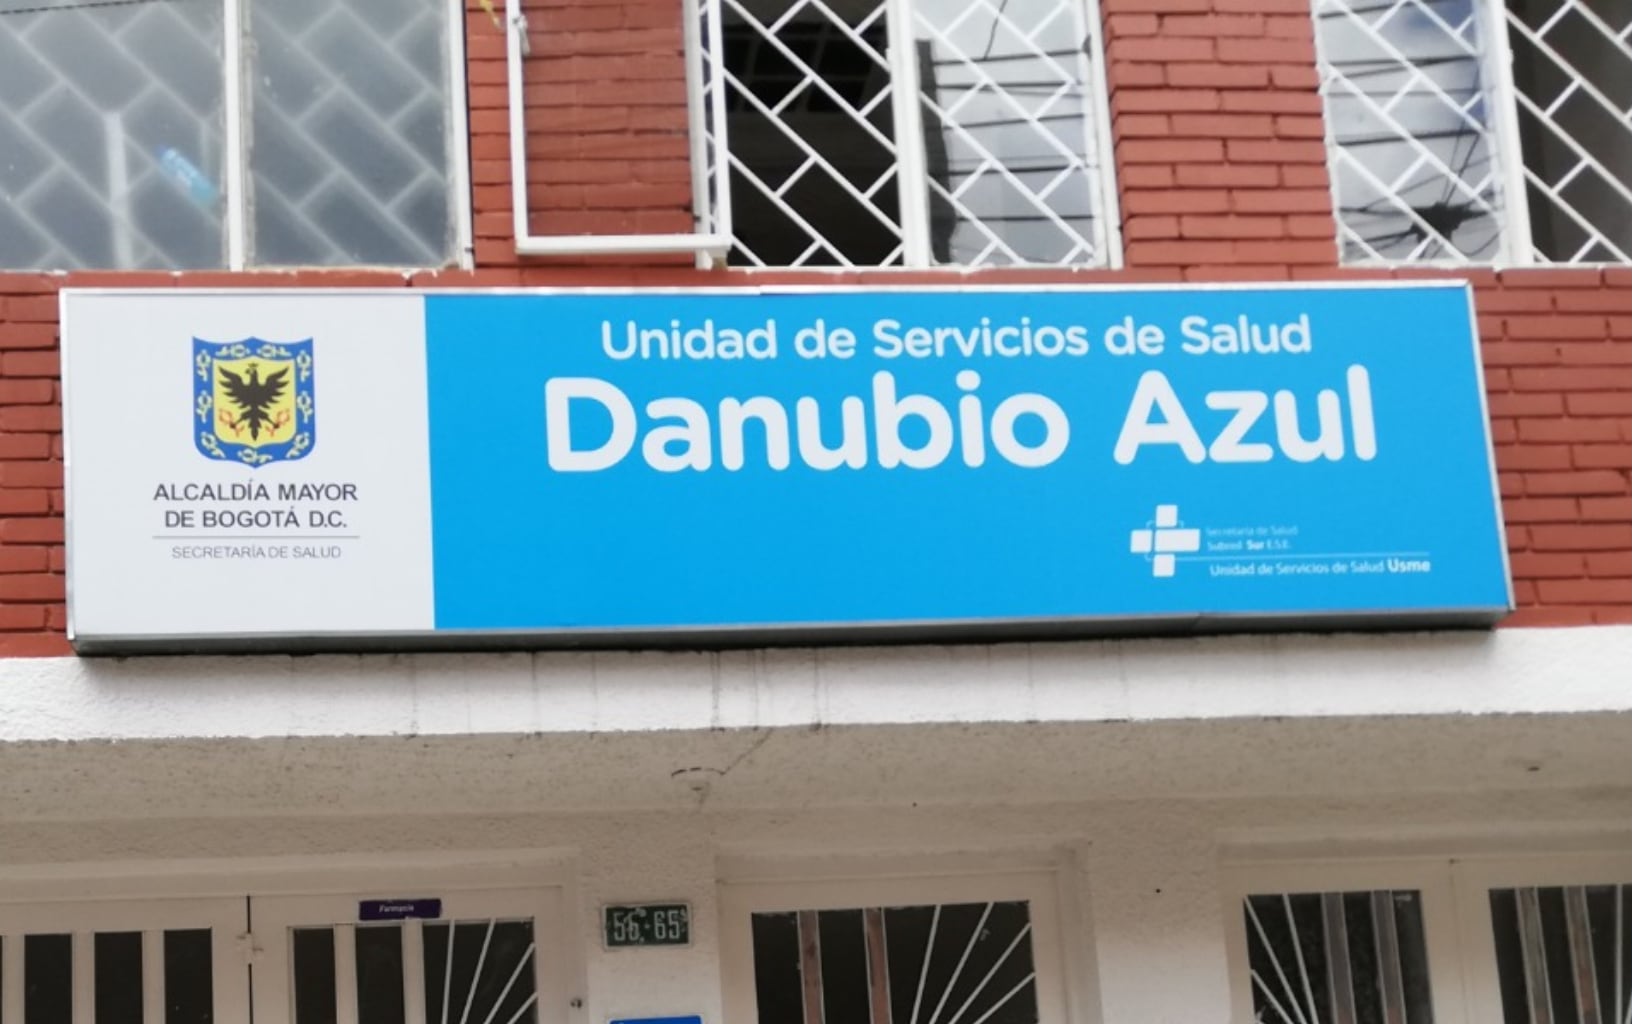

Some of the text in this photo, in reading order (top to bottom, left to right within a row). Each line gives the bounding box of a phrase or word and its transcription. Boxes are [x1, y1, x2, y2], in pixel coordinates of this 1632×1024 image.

[602, 313, 1312, 360] Unidad de Servicios de Salud
[545, 364, 1377, 473] Danubio Azul
[153, 478, 358, 501] ALCALDÍA MAYOR
[165, 505, 347, 528] DE BOGOTÁ D.C.
[171, 545, 342, 559] SECRETARÍA DE SALUD
[1210, 558, 1431, 577] Unidad de Servicios de Salud Usme
